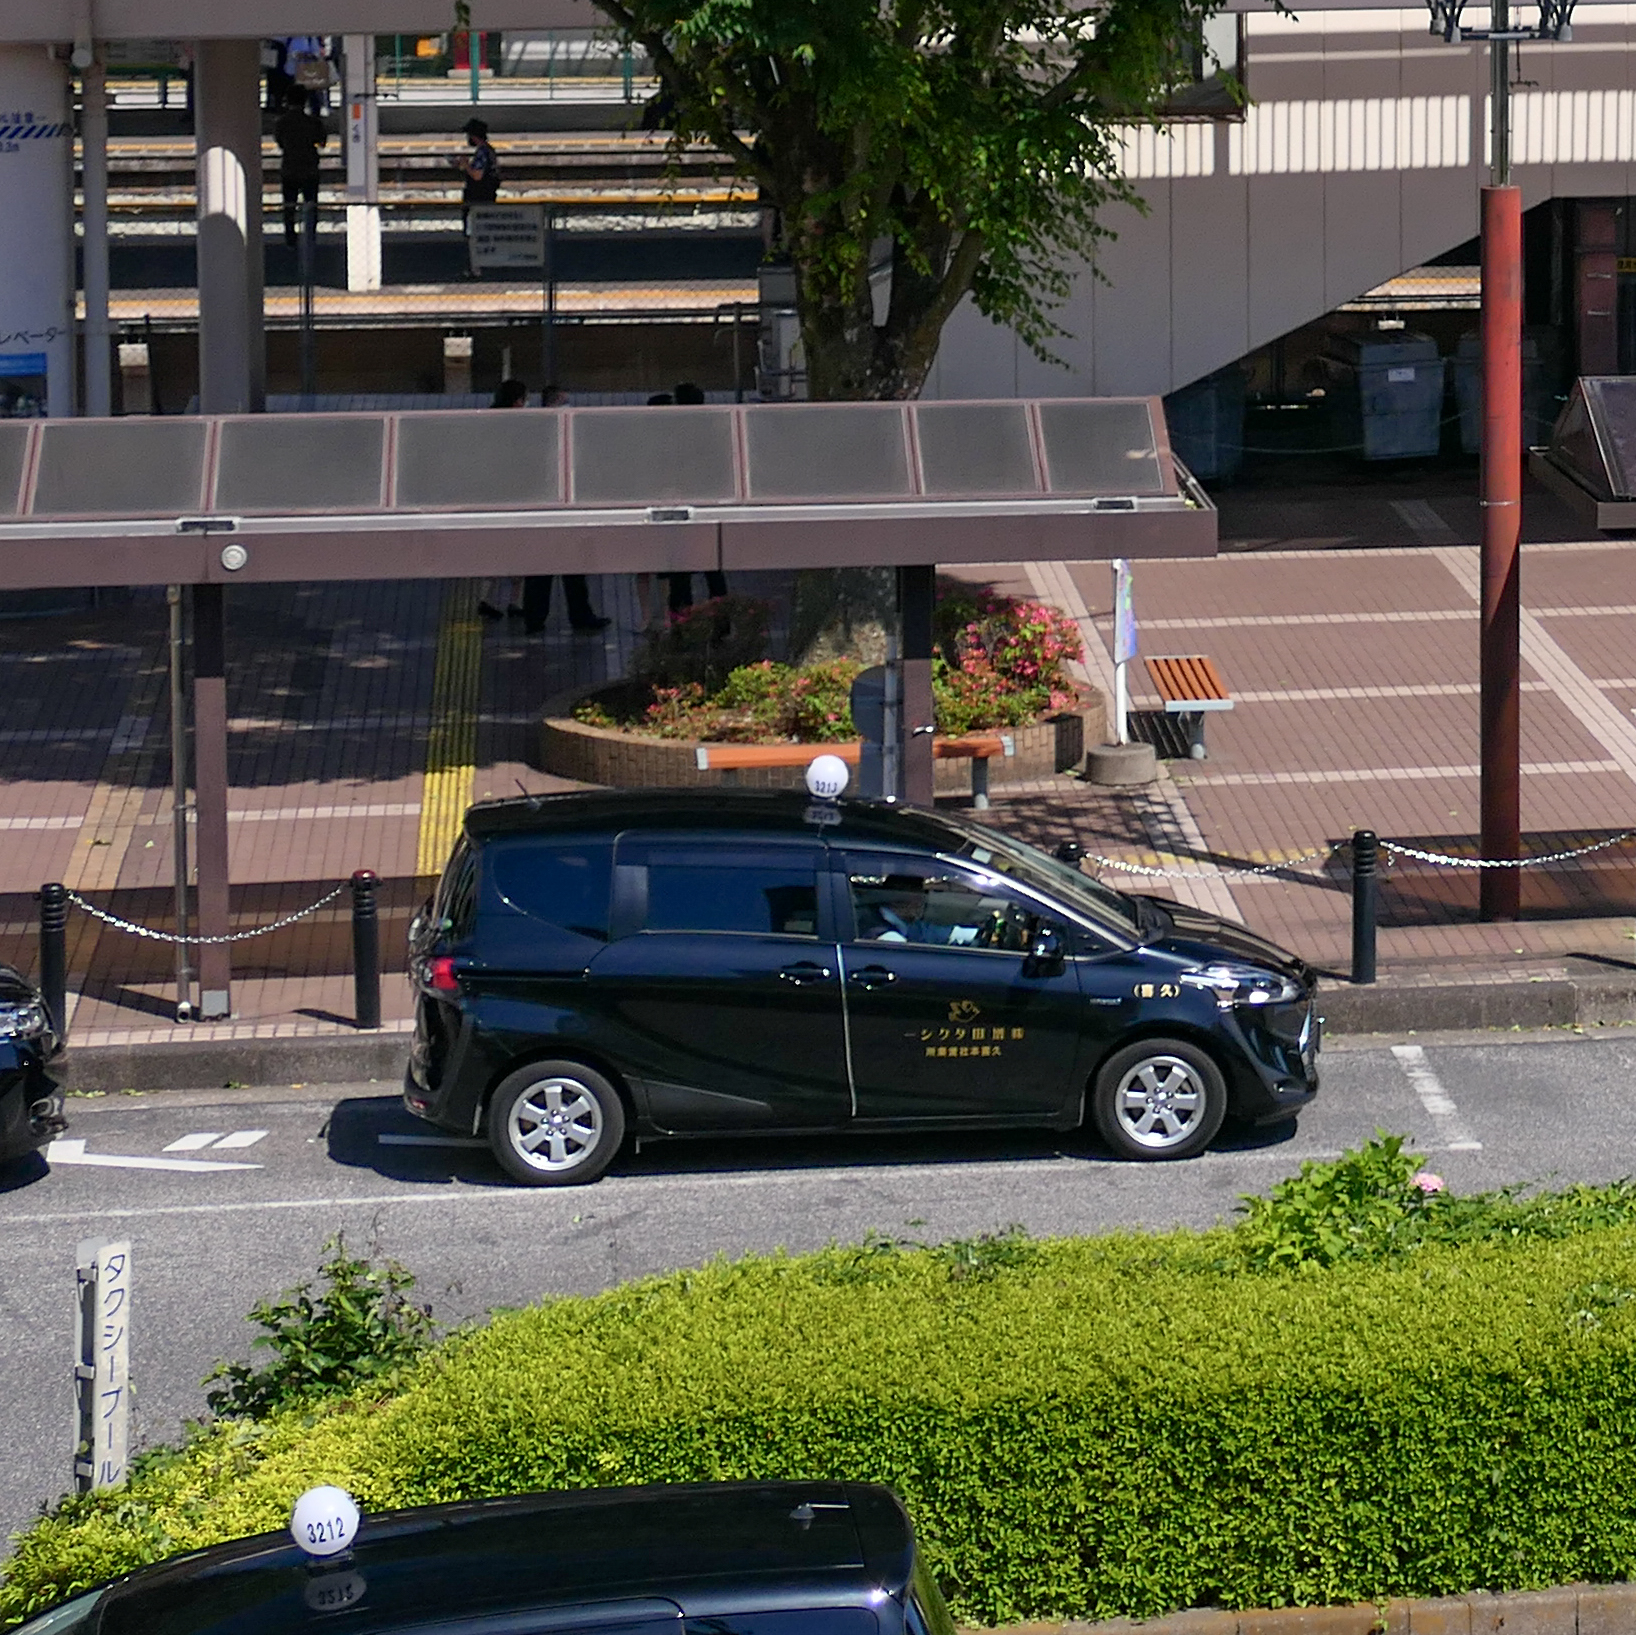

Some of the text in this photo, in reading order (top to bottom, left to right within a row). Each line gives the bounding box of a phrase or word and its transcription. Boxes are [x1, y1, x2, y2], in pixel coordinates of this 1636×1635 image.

[99, 1254, 127, 1484] タクシープール
[307, 1516, 345, 1544] 3212
